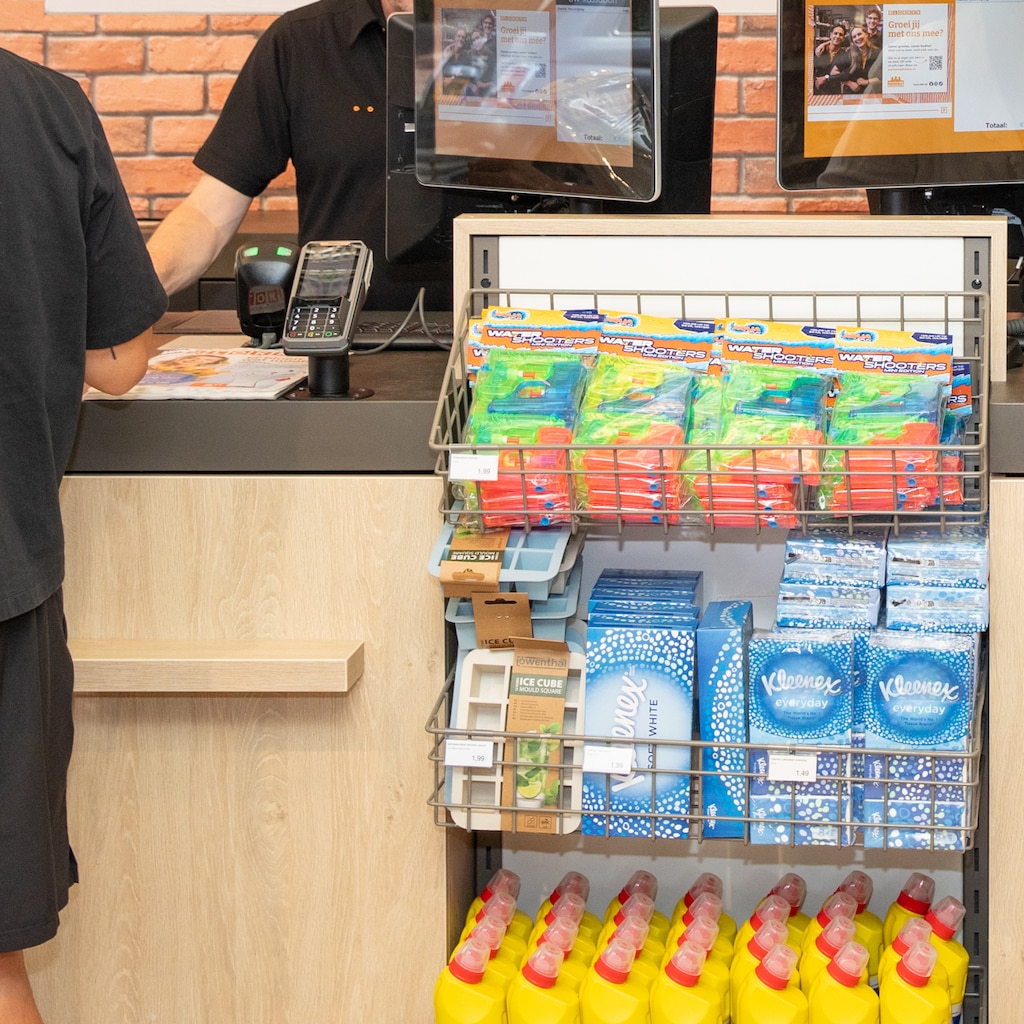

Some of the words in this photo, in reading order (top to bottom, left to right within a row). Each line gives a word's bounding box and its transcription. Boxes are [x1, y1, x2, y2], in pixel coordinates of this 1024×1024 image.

[888, 20, 911, 29] Groei
[912, 19, 920, 30] jij
[888, 30, 905, 38] met
[922, 29, 944, 37] mee?
[487, 330, 542, 338] WATER
[511, 336, 595, 344] SHOOTERS
[599, 336, 654, 347] WATER
[623, 345, 706, 358] SHOOTERS
[727, 344, 782, 354] WATER
[839, 353, 894, 362] WATER
[864, 362, 947, 371] SHOOTERS
[519, 677, 535, 686] ICE
[537, 678, 563, 688] CUBE
[761, 668, 841, 696] Kleenex
[879, 674, 959, 703] Kleenex
[775, 698, 828, 709] everyday
[892, 704, 946, 716] everyday
[648, 699, 658, 737] WHITE
[612, 675, 648, 793] Kenex
